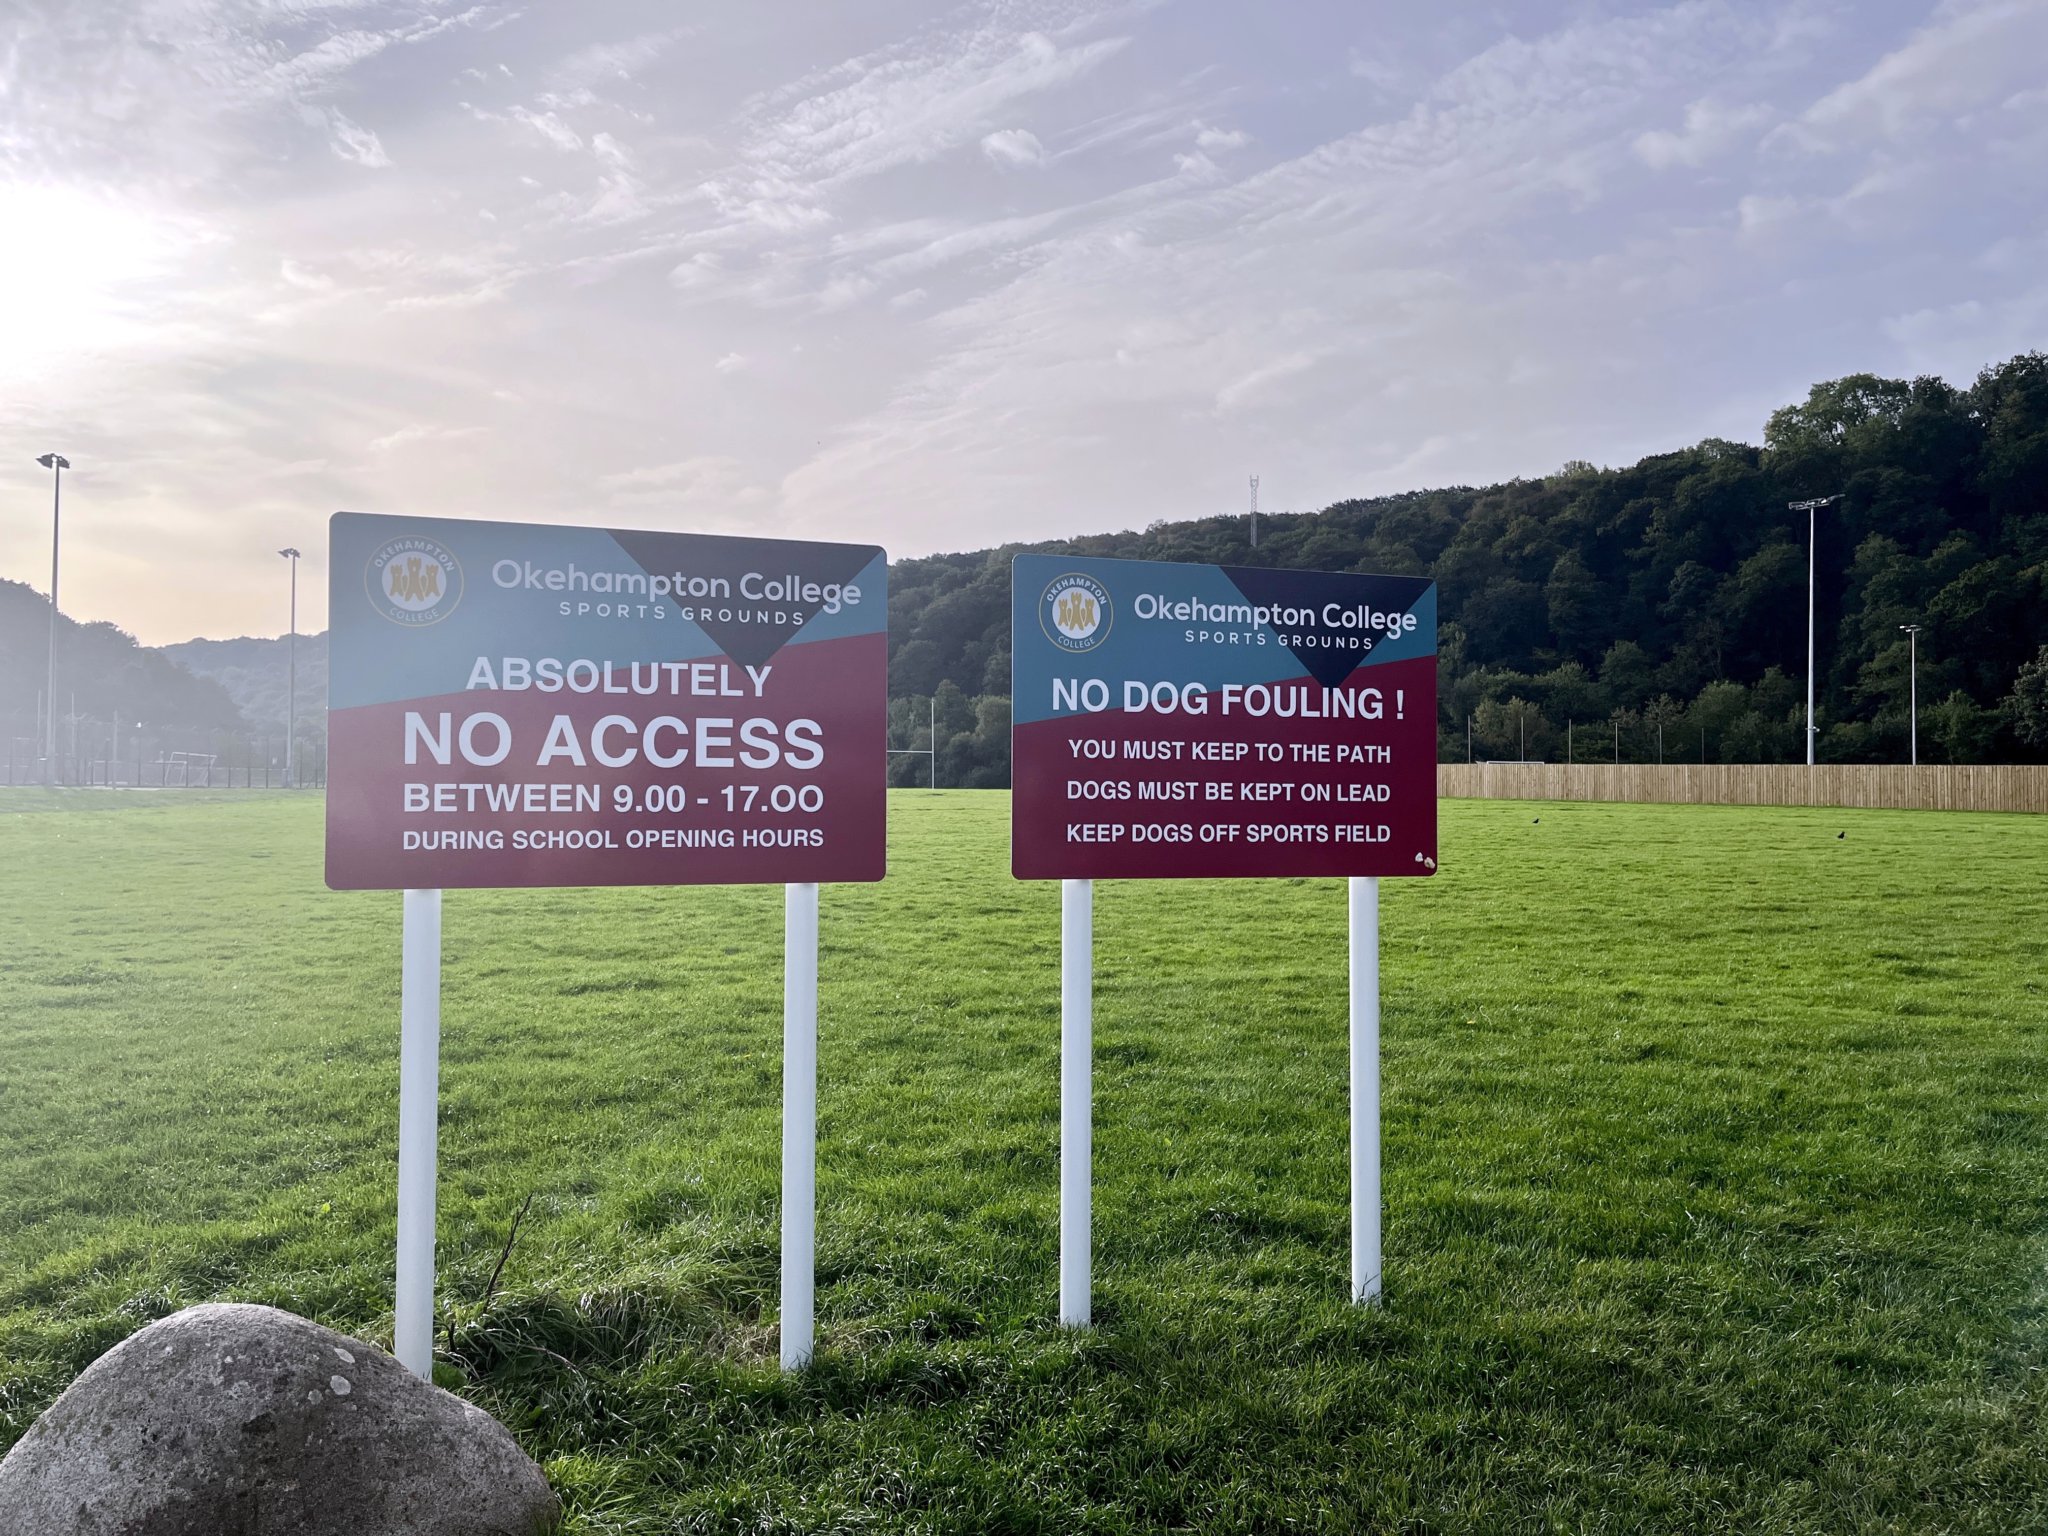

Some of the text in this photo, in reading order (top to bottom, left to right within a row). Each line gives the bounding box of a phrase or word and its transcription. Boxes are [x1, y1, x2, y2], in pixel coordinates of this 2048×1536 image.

[374, 540, 455, 572] OKEHAMPTON
[492, 559, 861, 614] Okehampton College
[1046, 577, 1107, 605] OKEHAMPTON
[390, 607, 439, 622] COLLEGE
[559, 601, 804, 626] SPORTS GROUNDS
[1134, 593, 1417, 639] Okehampton College
[1058, 635, 1096, 649] COLLEGE
[1185, 629, 1372, 650] SPORTS GROUNDS
[466, 657, 772, 697] ABSOLUTELY
[1052, 678, 1405, 720] NO DOG FOULING !
[404, 711, 824, 770] NO ACCESS
[1069, 740, 1391, 764] YOU MUST KEEP TO THE PATH
[404, 783, 600, 813] BETWEEN
[613, 784, 686, 813] 9.00
[1067, 780, 1391, 802] DOGS MUST BE KEPT ON LEAD
[403, 828, 824, 850] DURING SCHOOL OPENING HOURS
[1067, 824, 1391, 843] KEEP DOGS OFF SPORTS FIELD
